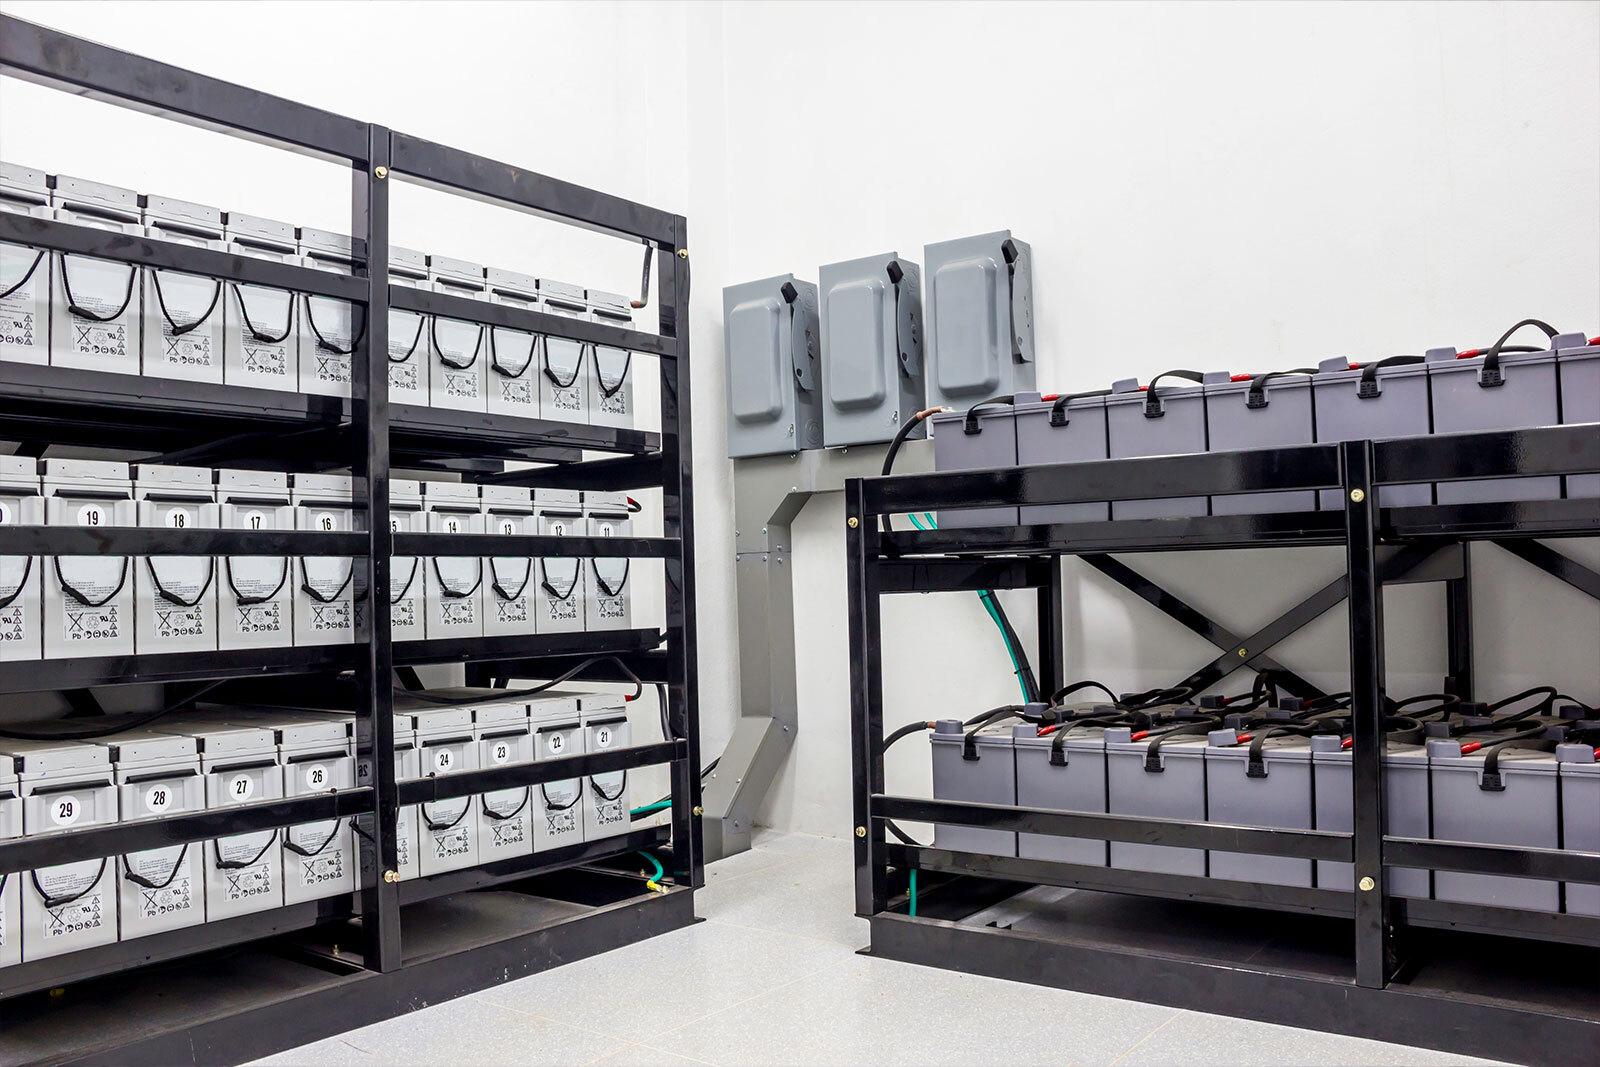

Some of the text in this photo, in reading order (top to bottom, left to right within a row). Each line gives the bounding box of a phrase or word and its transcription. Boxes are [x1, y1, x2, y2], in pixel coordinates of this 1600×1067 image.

[86, 511, 98, 525] 19
[174, 514, 184, 528] 18
[251, 516, 260, 529] 17
[322, 518, 331, 530] 16
[449, 522, 456, 533] 14
[504, 524, 511, 535] 13
[555, 525, 562, 536] 12
[604, 527, 609, 537] 11
[553, 737, 561, 748] 22
[601, 732, 607, 742] 21
[498, 747, 505, 758] 23
[440, 754, 448, 765] 24
[312, 770, 322, 783] 26
[237, 780, 247, 794] 27
[153, 791, 165, 805] 28
[60, 802, 73, 817] 29
